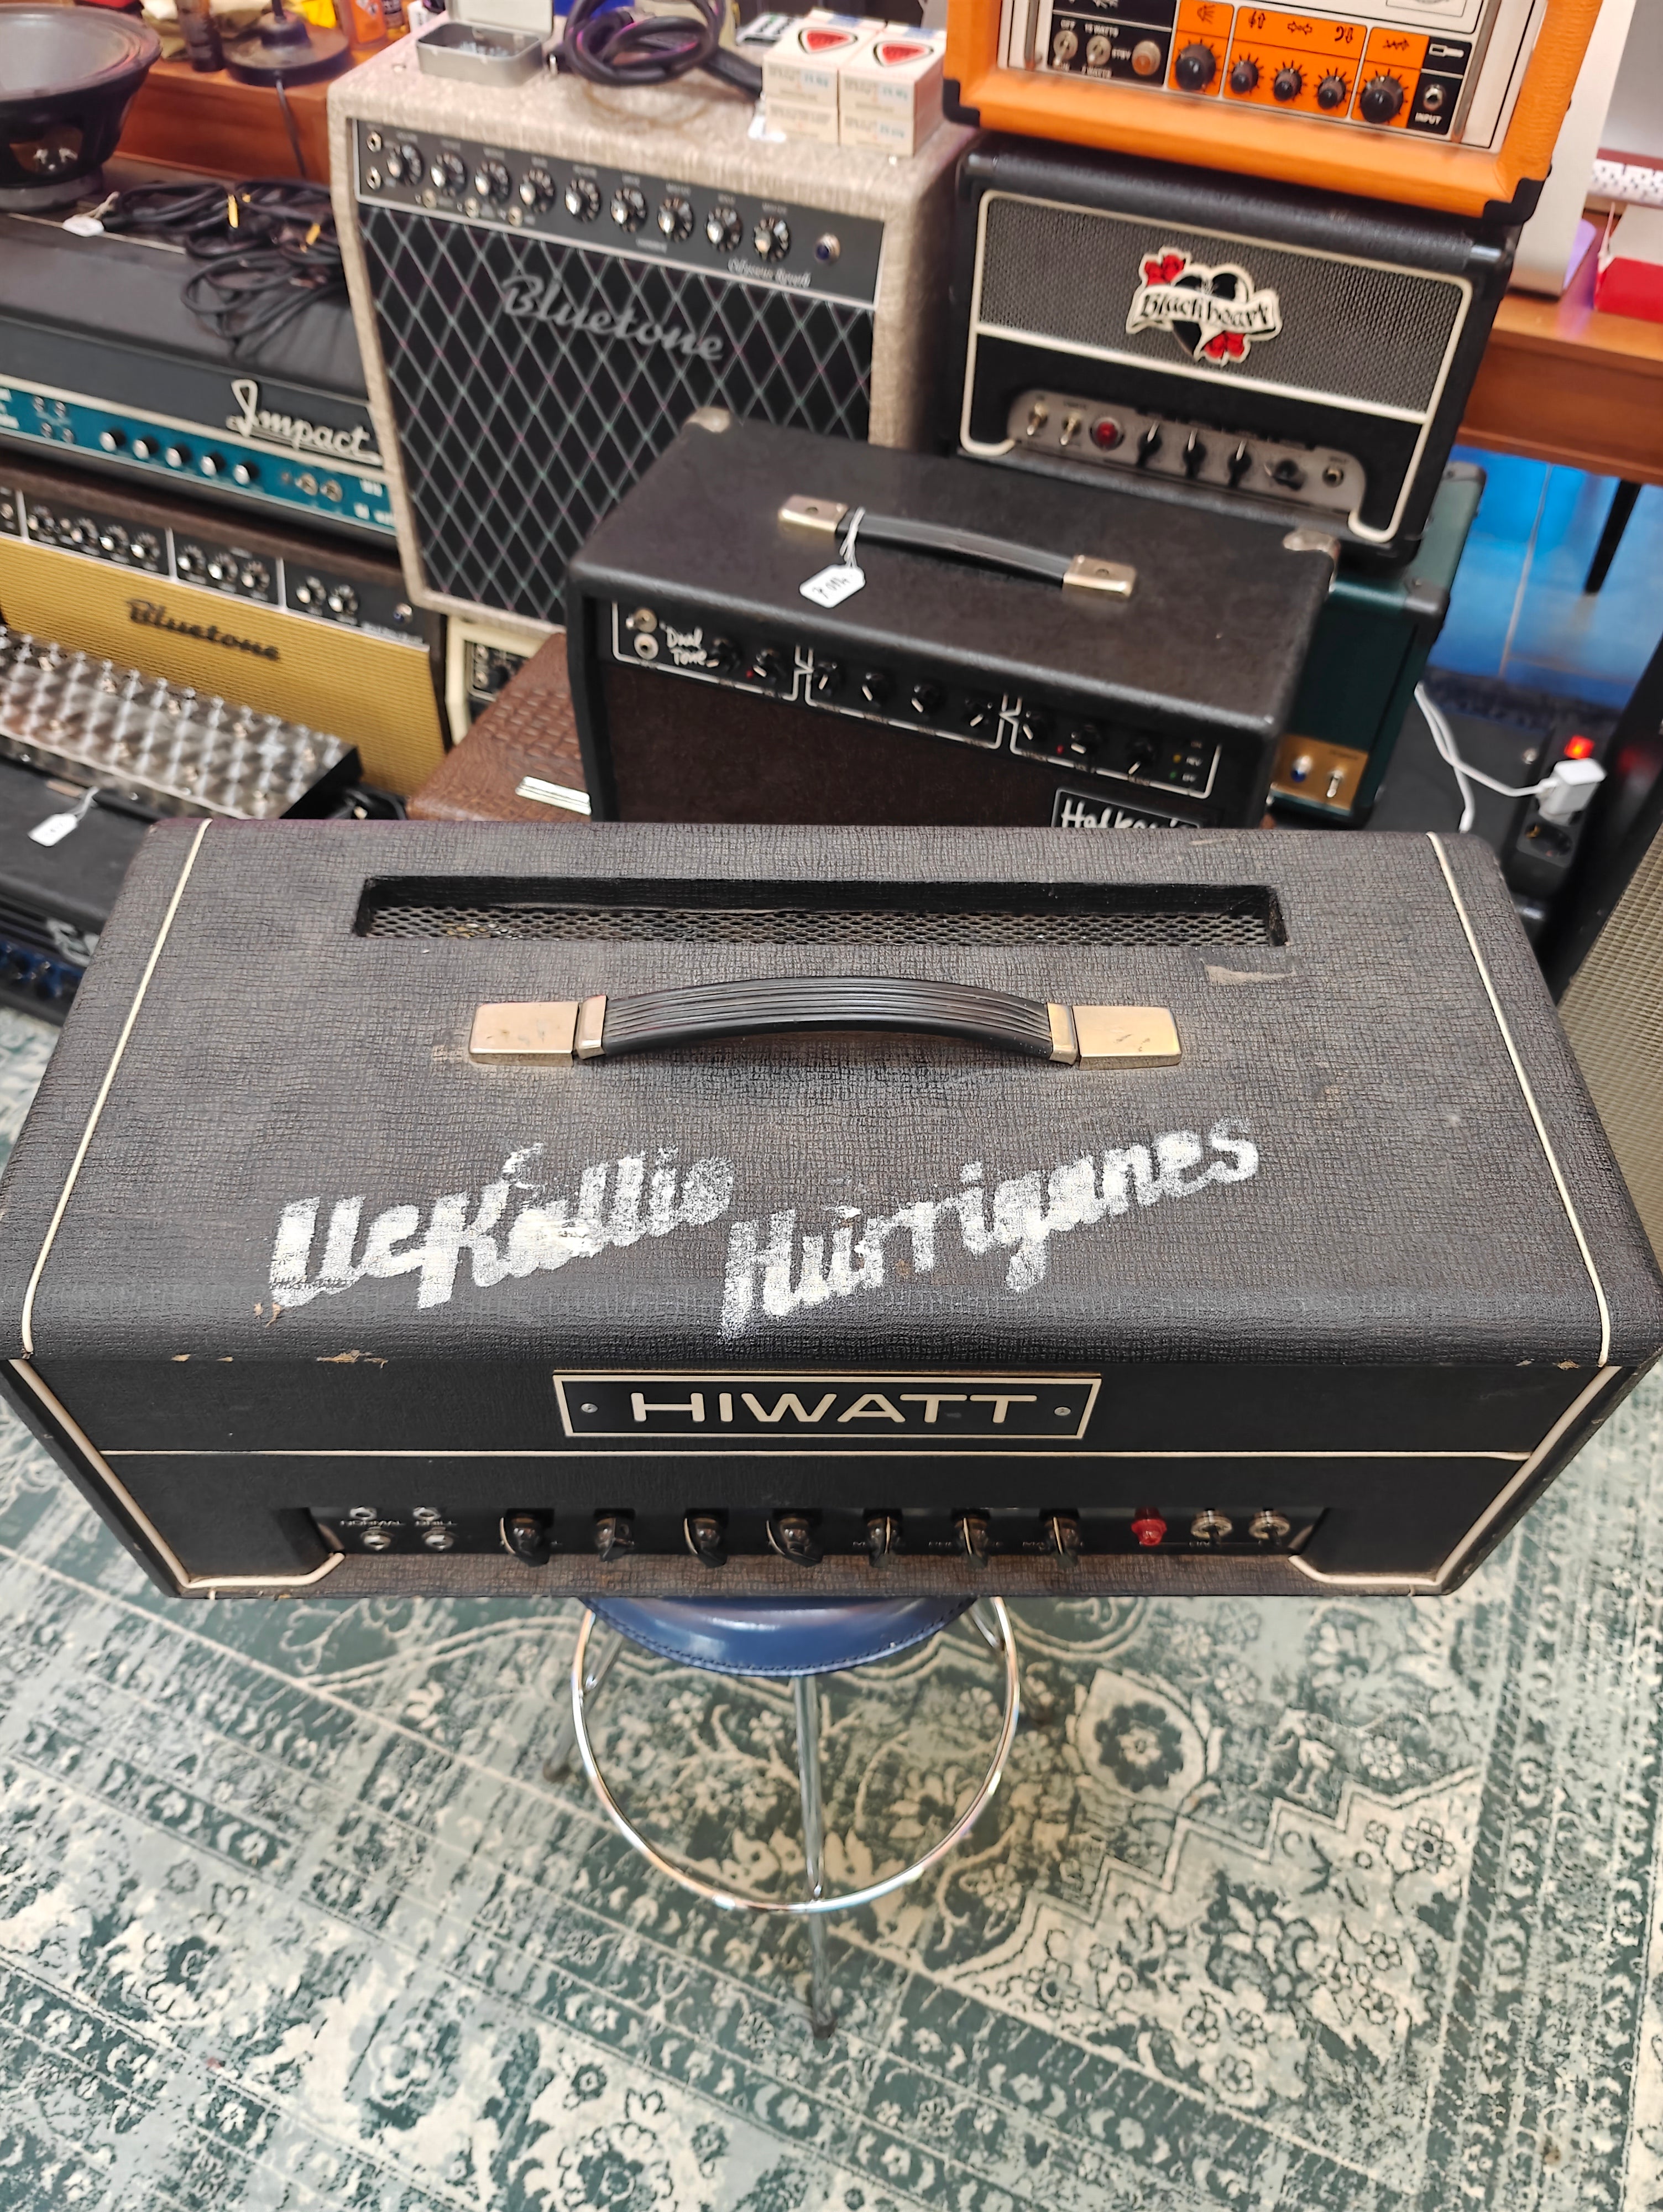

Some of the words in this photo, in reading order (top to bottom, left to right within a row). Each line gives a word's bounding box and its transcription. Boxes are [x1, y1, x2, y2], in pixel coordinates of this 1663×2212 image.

[501, 274, 724, 360] Bluetone
[226, 379, 383, 466] Impact
[127, 599, 280, 661] Bluetone
[659, 622, 703, 649] Dual
[670, 648, 707, 666] Tone
[630, 1392, 1038, 1423] HIWATT
